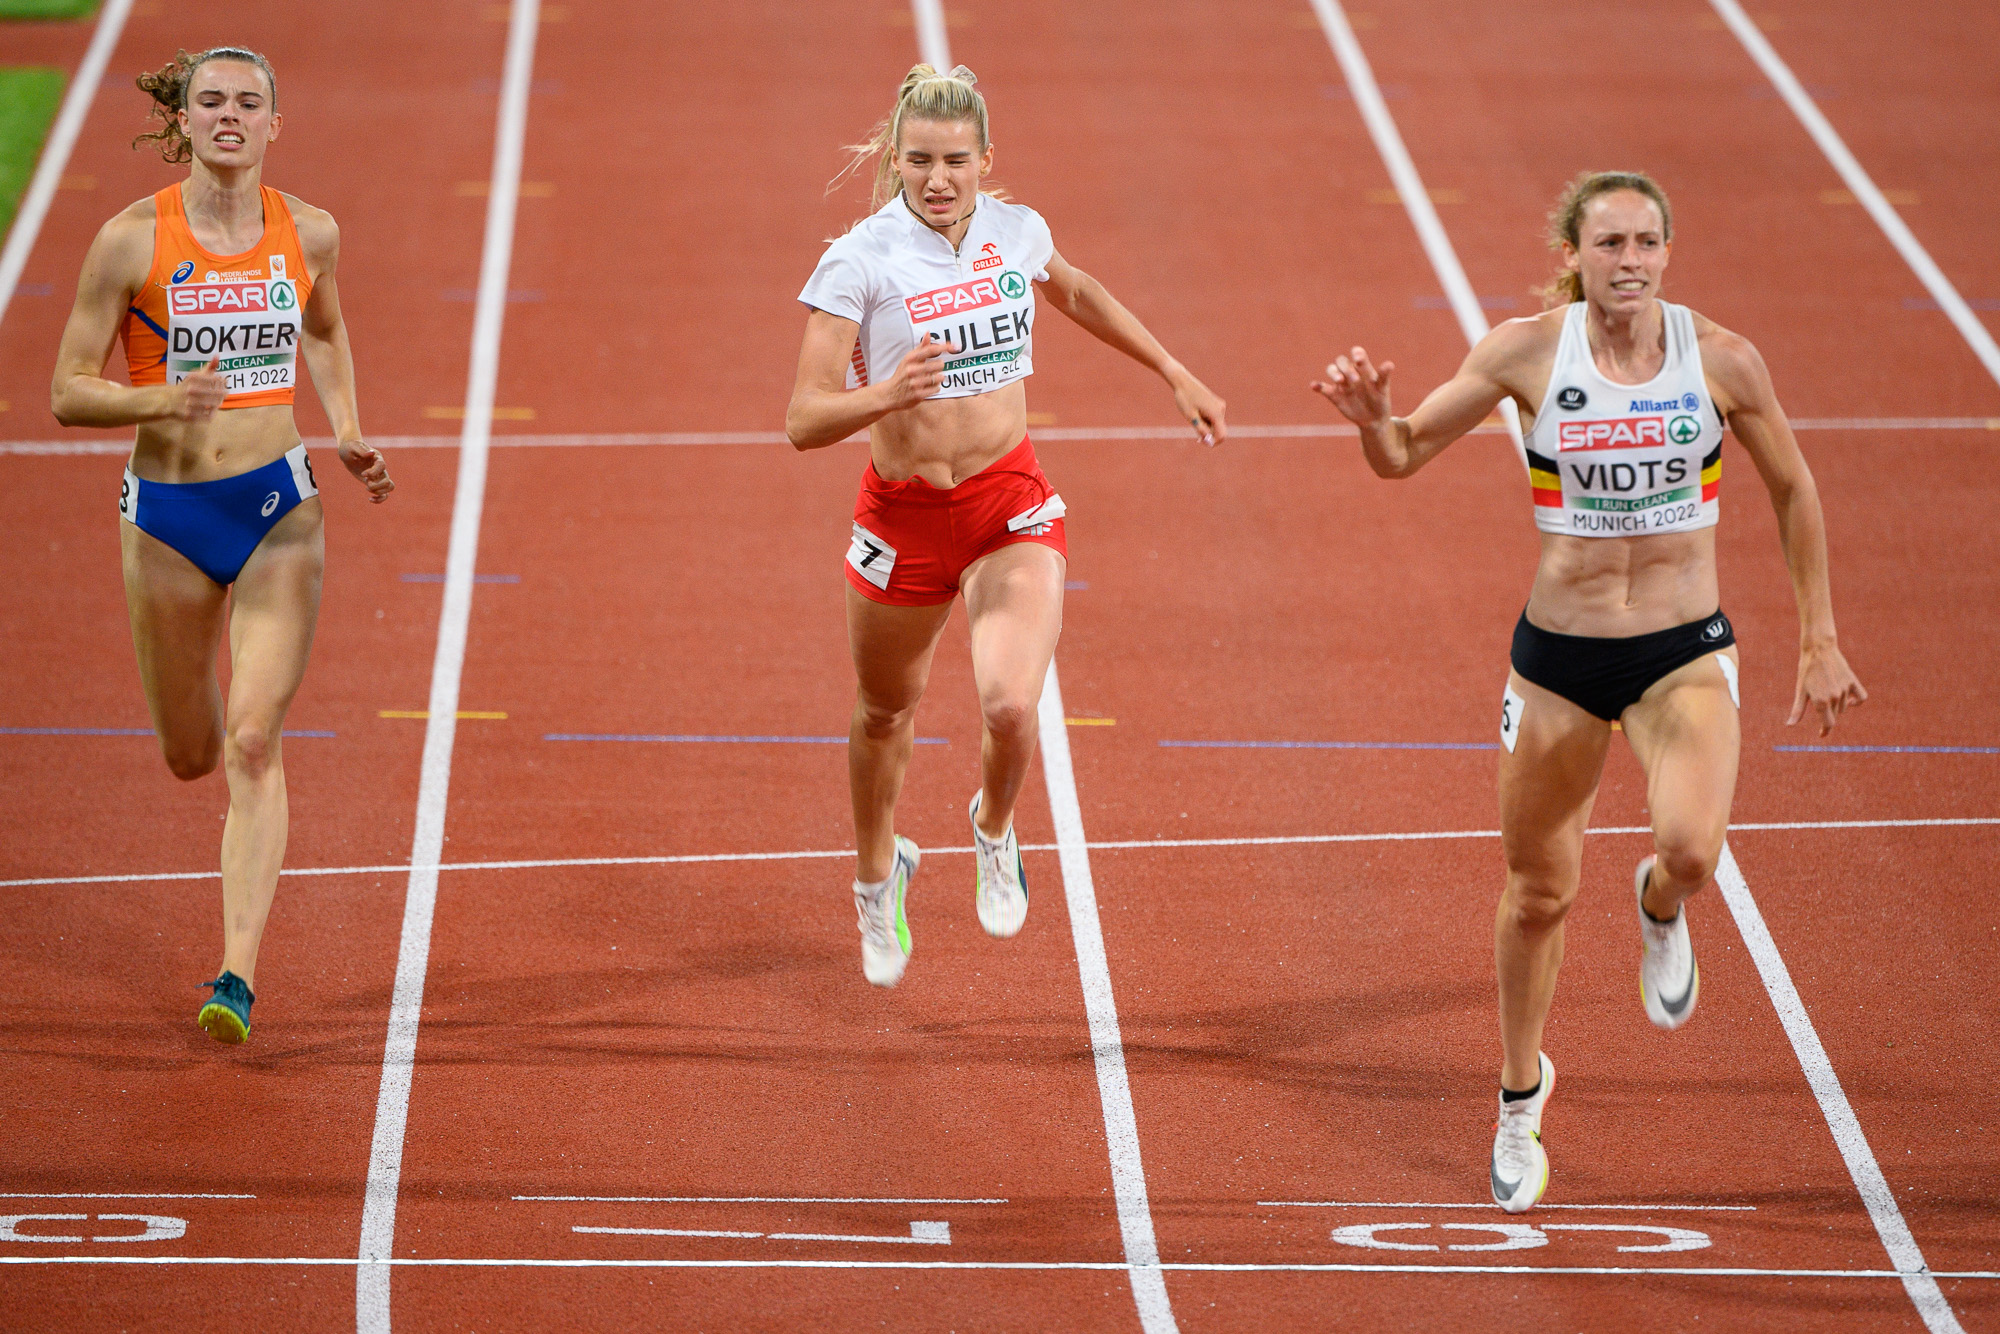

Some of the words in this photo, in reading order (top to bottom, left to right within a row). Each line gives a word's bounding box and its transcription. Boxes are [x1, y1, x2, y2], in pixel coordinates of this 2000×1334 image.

[220, 269, 262, 278] NEDERLANDSE
[974, 257, 1001, 270] ORLEN
[174, 287, 265, 311] SPAR
[909, 281, 998, 319] SPAR
[173, 322, 295, 354] DOKTER
[952, 357, 977, 370] RUN
[250, 368, 289, 387] 2022
[941, 367, 996, 389] UNICH
[1629, 399, 1680, 413] Allianz
[1561, 420, 1664, 449] SPAR
[1571, 457, 1688, 492] VIDTS
[1602, 499, 1628, 511] RUN
[1573, 513, 1647, 531] MUNICH
[1653, 503, 1697, 527] 2022
[860, 538, 884, 569] 7
